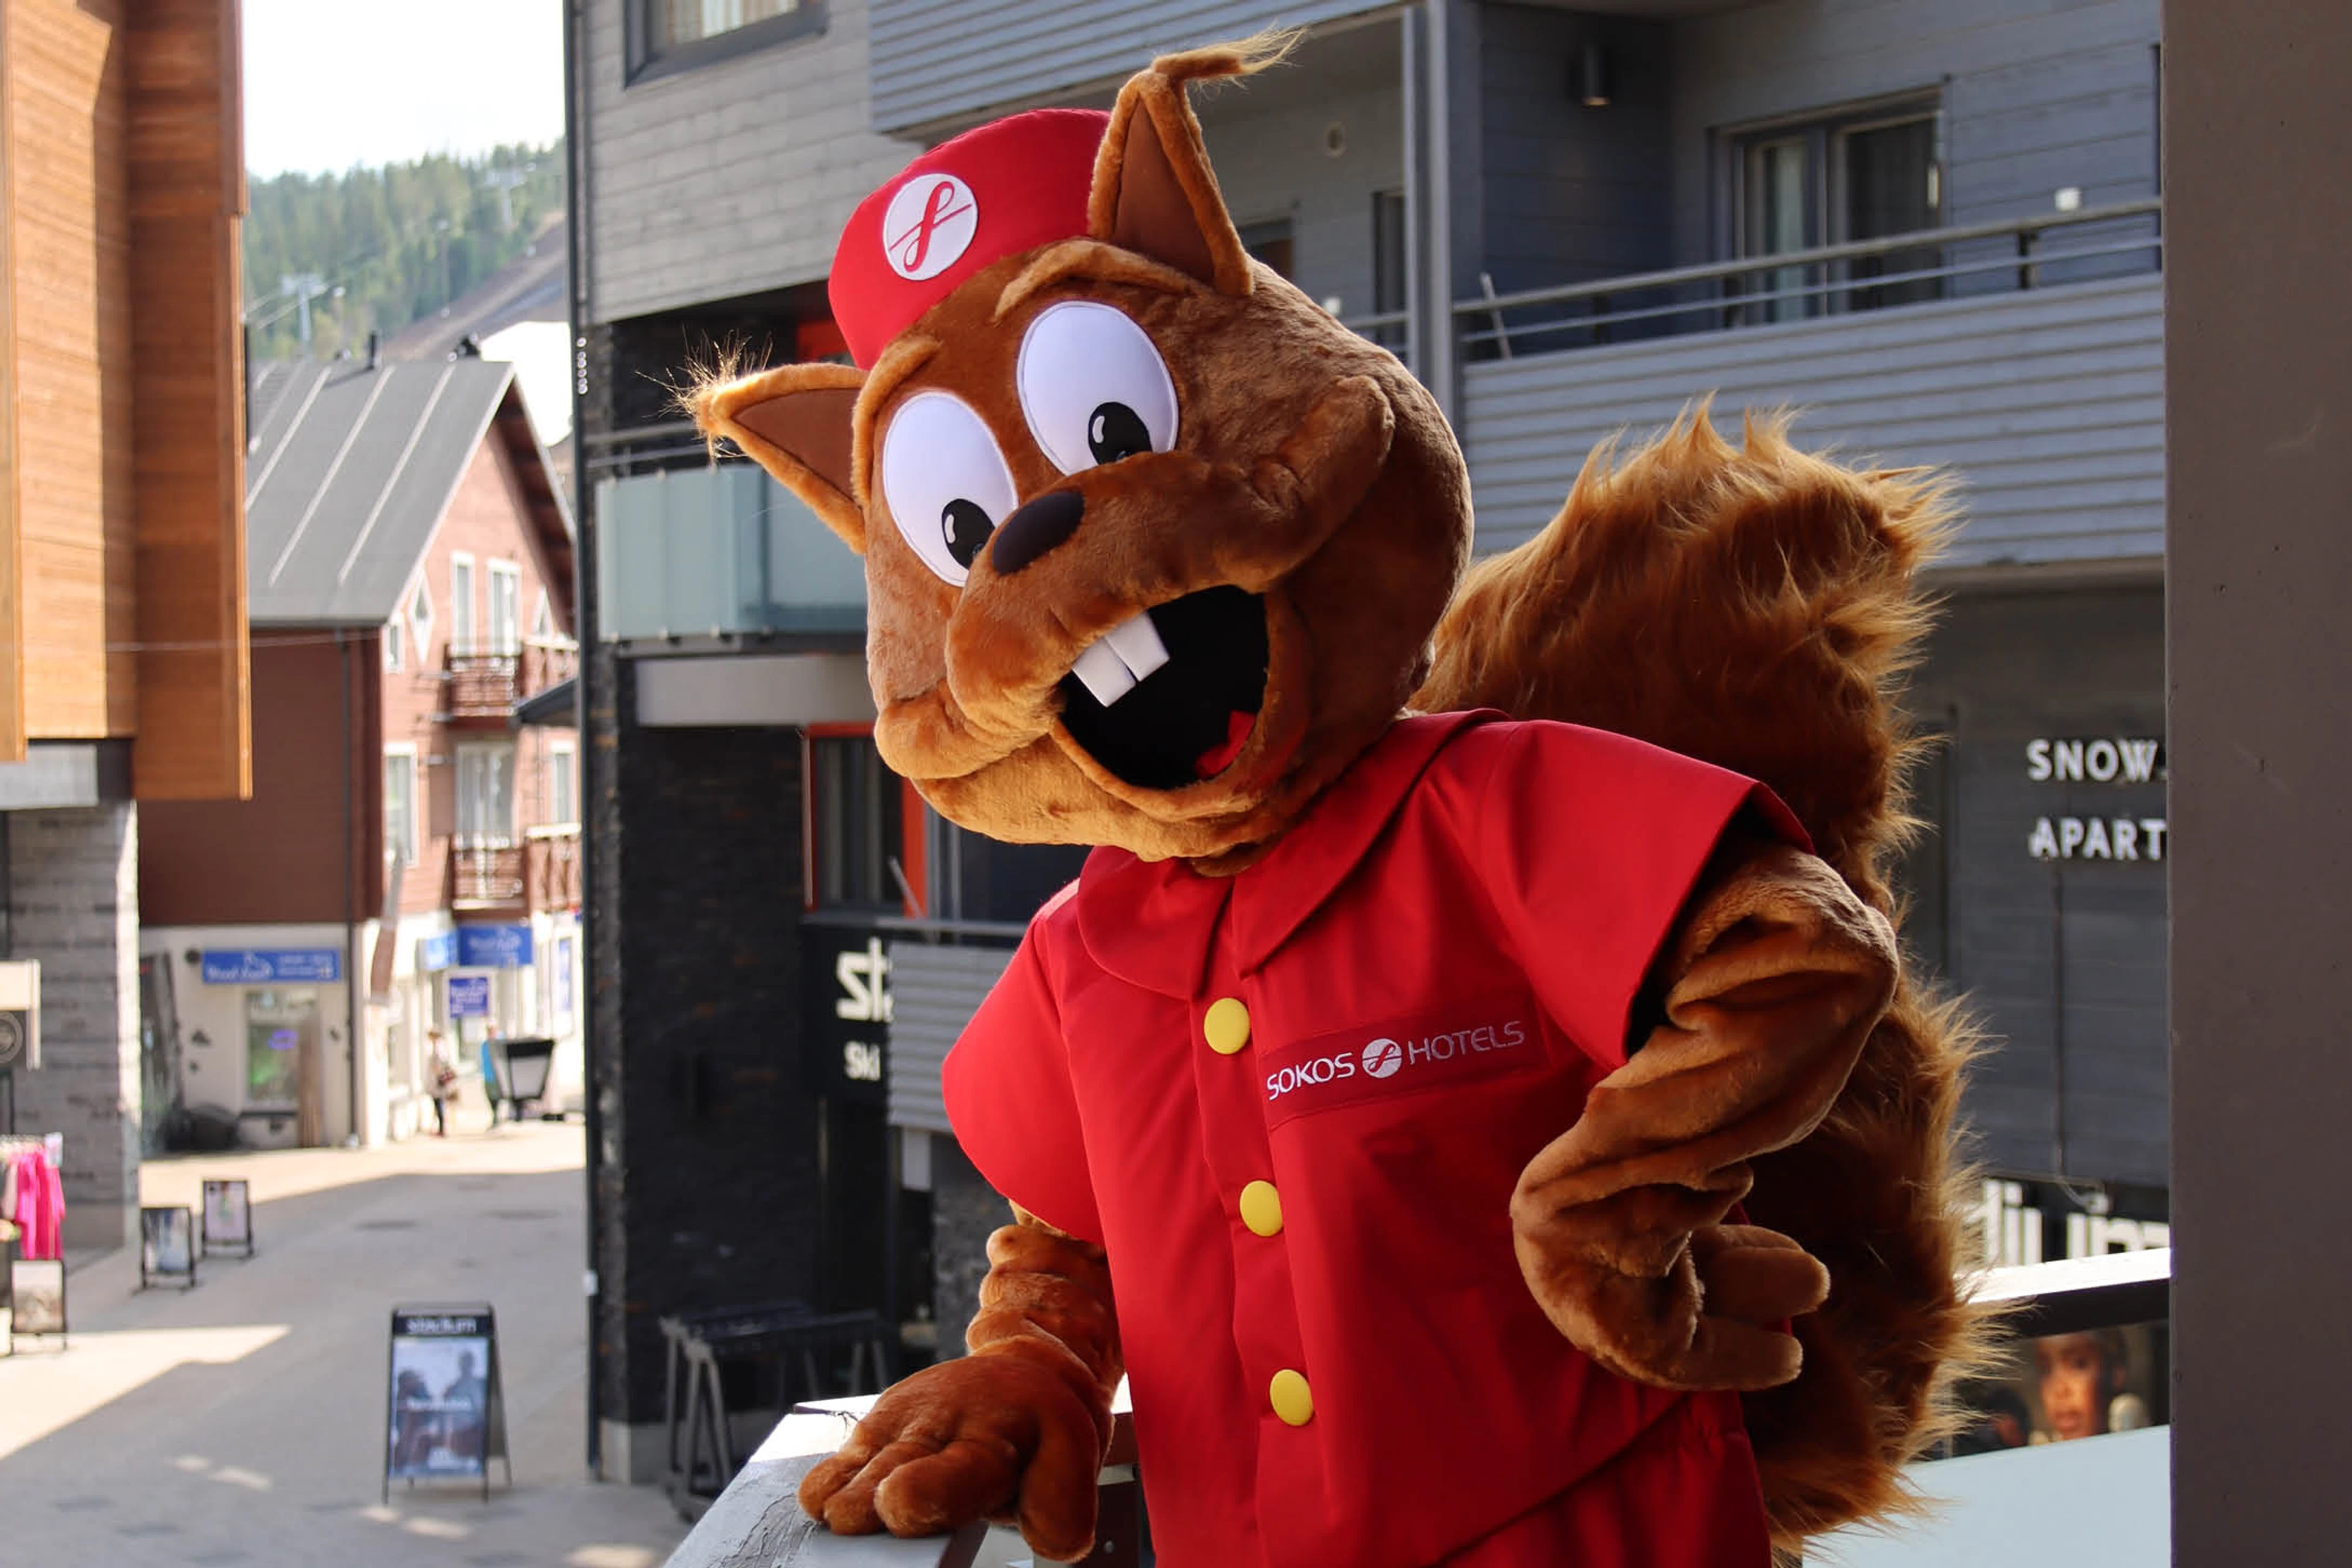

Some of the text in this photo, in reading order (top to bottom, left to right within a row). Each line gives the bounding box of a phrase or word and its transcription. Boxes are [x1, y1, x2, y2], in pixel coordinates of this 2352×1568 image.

[2027, 739, 2168, 782] SNOW
[2028, 816, 2167, 861] APART
[1267, 1021, 1525, 1100] SOKOS HOTELS
